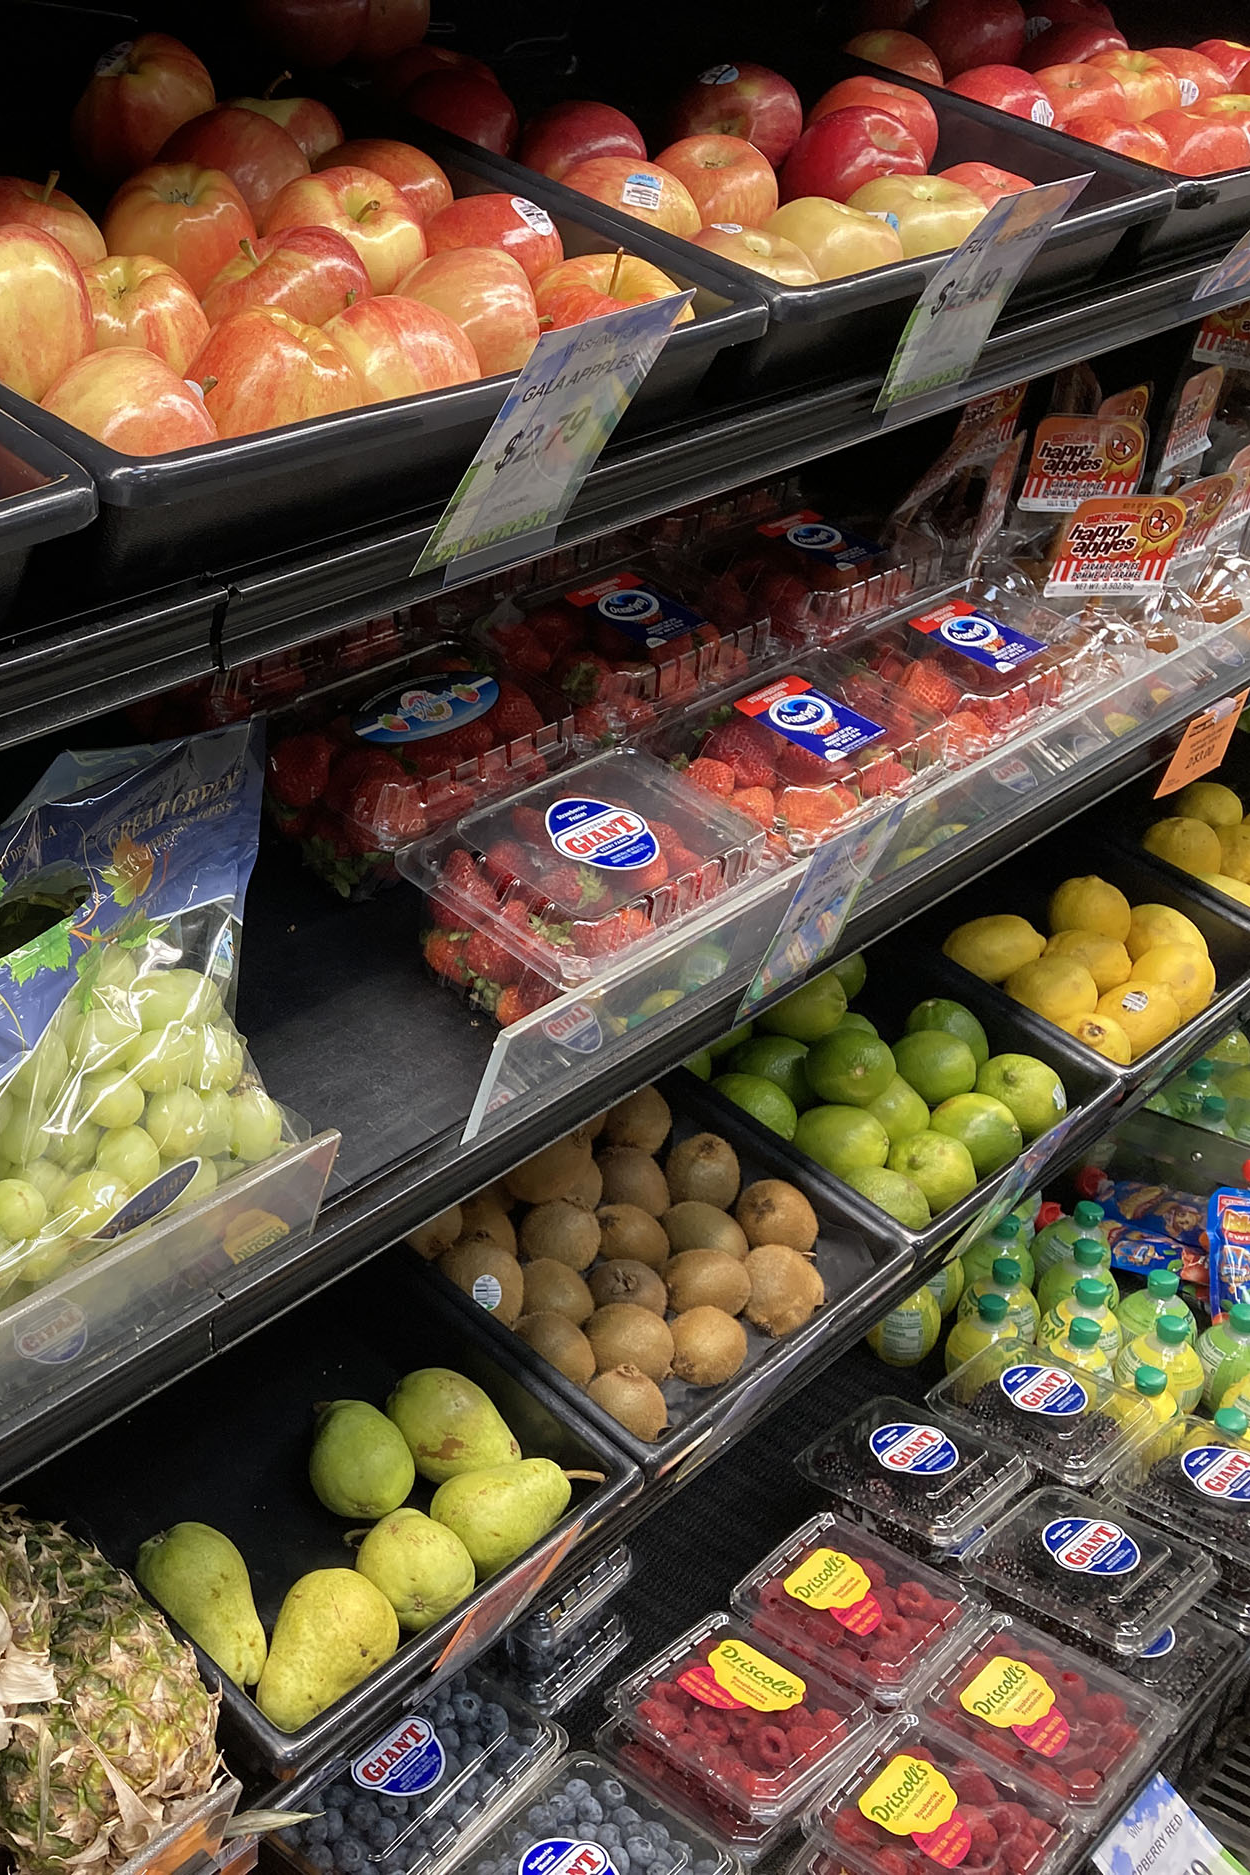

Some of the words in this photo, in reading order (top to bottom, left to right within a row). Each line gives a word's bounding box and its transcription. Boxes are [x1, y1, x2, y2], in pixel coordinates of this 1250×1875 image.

[522, 375, 566, 403] GALA
[494, 405, 592, 476] $2.79
[1039, 441, 1095, 461] happy
[1043, 458, 1103, 476] apples
[1069, 524, 1130, 543] happy
[1072, 537, 1137, 558] apples
[1071, 571, 1101, 579] POMME
[1110, 571, 1143, 579] CARAMEL
[1080, 562, 1113, 571] CARAMEL
[1114, 562, 1140, 571] APPLES
[1074, 583, 1089, 591] NET
[780, 709, 805, 723] Ocean
[800, 702, 822, 719] Spray
[564, 815, 639, 855] GIANT
[575, 819, 607, 837] CALIFORNIA
[599, 842, 616, 853] BERRY
[614, 836, 631, 848] FARMS
[1020, 1372, 1067, 1407] GIANT
[888, 1430, 939, 1466] GIANT
[1204, 1454, 1250, 1492] GIANT
[1065, 1525, 1117, 1565] GIANT
[794, 1555, 846, 1599] Driscoll's
[720, 1645, 800, 1699] Driscoll's
[972, 1663, 1026, 1715] Driscoll's
[361, 1722, 427, 1782] GIANT
[870, 1762, 929, 1823] Driscoll's
[914, 1790, 940, 1819] Raspberries
[921, 1793, 947, 1821] Framboises
[1164, 1813, 1183, 1839] RED
